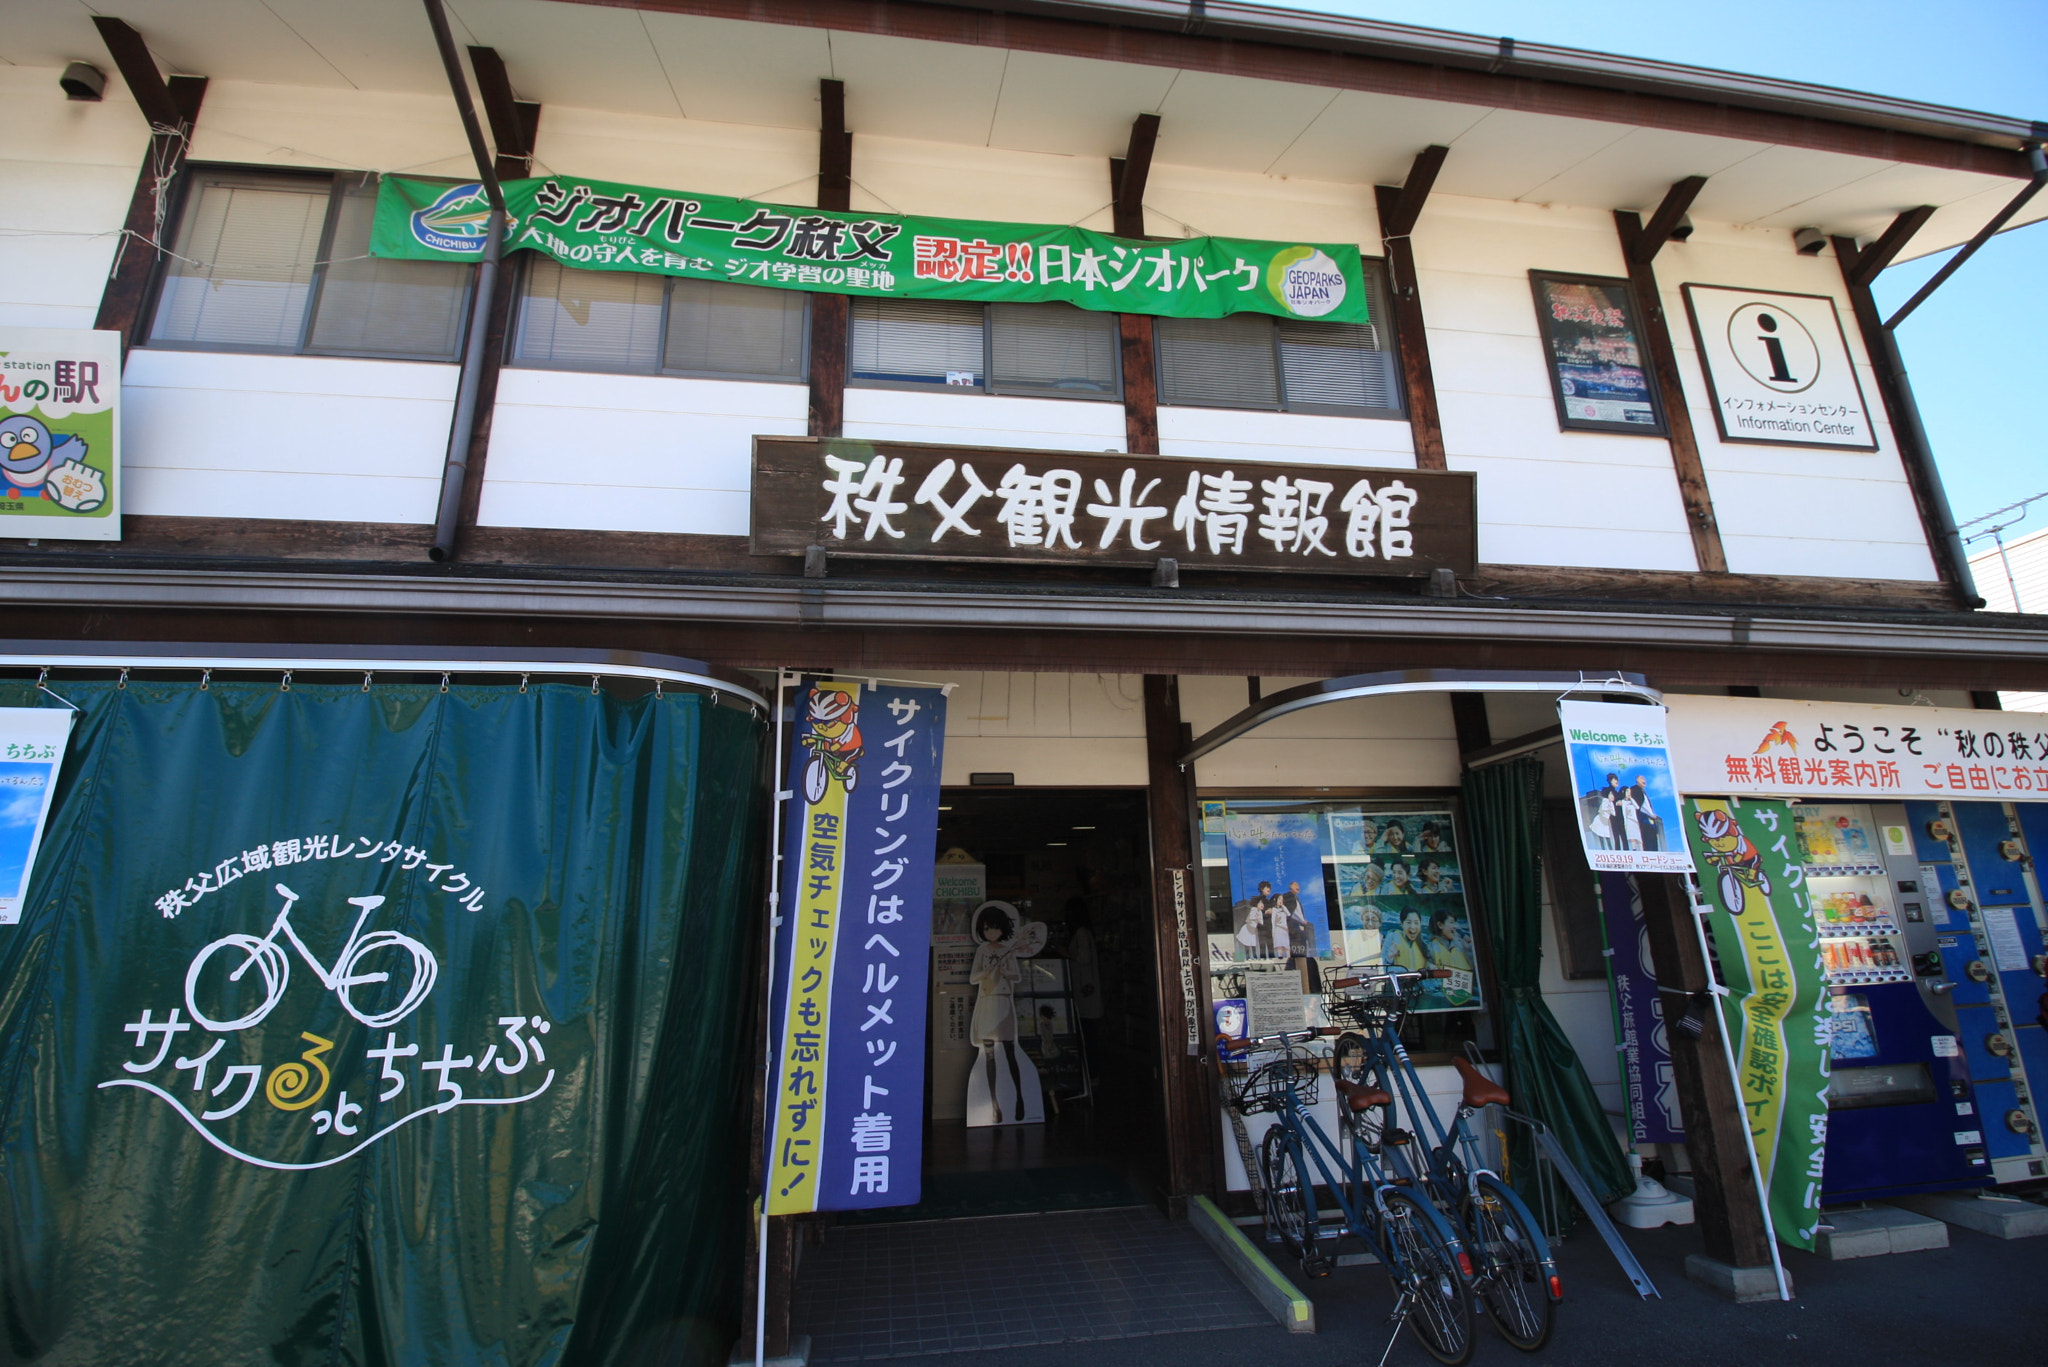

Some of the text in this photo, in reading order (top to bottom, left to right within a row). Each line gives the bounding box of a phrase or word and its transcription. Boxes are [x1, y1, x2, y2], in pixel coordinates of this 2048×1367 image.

[527, 181, 900, 263] ジオパーク秩父
[425, 234, 478, 251] CHICHIBU
[599, 235, 636, 246] もりびと
[519, 226, 895, 292] 大地の守人を育む ジオ学習の聖地
[1288, 269, 1343, 287] GEOPARKS
[1288, 286, 1330, 300] JAPAN
[4, 361, 51, 371] station
[1723, 397, 1859, 417] インフォメーションセンター
[1738, 415, 1855, 437] Information Center
[62, 474, 94, 493] おむつ
[63, 485, 83, 501] 替え
[821, 454, 1418, 560] 秩父観光情報館
[1569, 728, 1665, 746] Welcome ちちぶ
[1814, 723, 1922, 755] ようこそ
[7, 743, 56, 760] ちちぶ
[1725, 755, 1901, 788] 無料観光案内所
[1595, 854, 1683, 865] 2015.9.19 ロードショー
[156, 835, 484, 919] 秩父広域観光レンタサイクル
[938, 877, 977, 887] Welcome
[936, 887, 980, 897] CHICHIBU
[851, 697, 921, 1195] サイクリングはヘルメット着用
[780, 812, 840, 1197] 空気チェックも忘れずに!
[1745, 921, 1790, 1157] ここは安全確認ポイン
[1617, 973, 1648, 1140] 秩父旅館業協同組合
